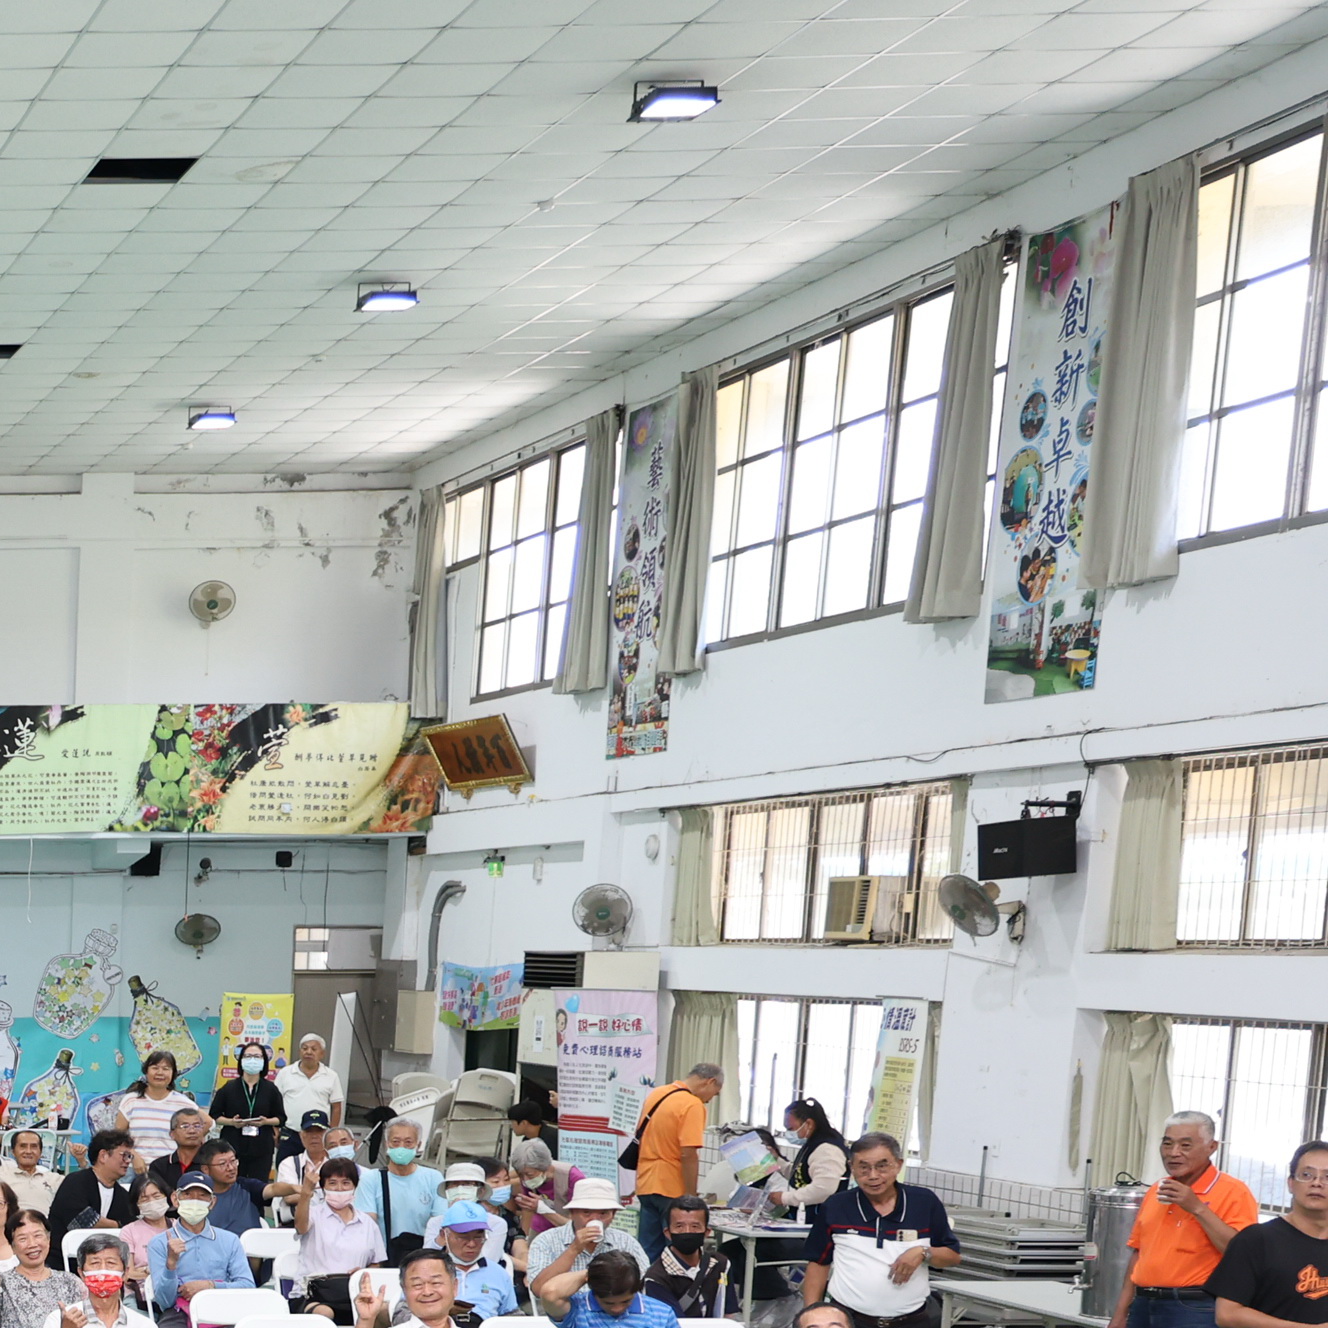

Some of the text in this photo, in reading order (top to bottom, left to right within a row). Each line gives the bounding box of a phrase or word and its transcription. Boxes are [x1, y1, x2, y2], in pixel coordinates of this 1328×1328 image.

[1036, 276, 1093, 547] 創新卓越
[633, 439, 665, 643] 藝術領航
[3, 717, 45, 761] 蓮
[257, 724, 289, 771] 萱
[577, 1018, 643, 1033] 說一說 好心情
